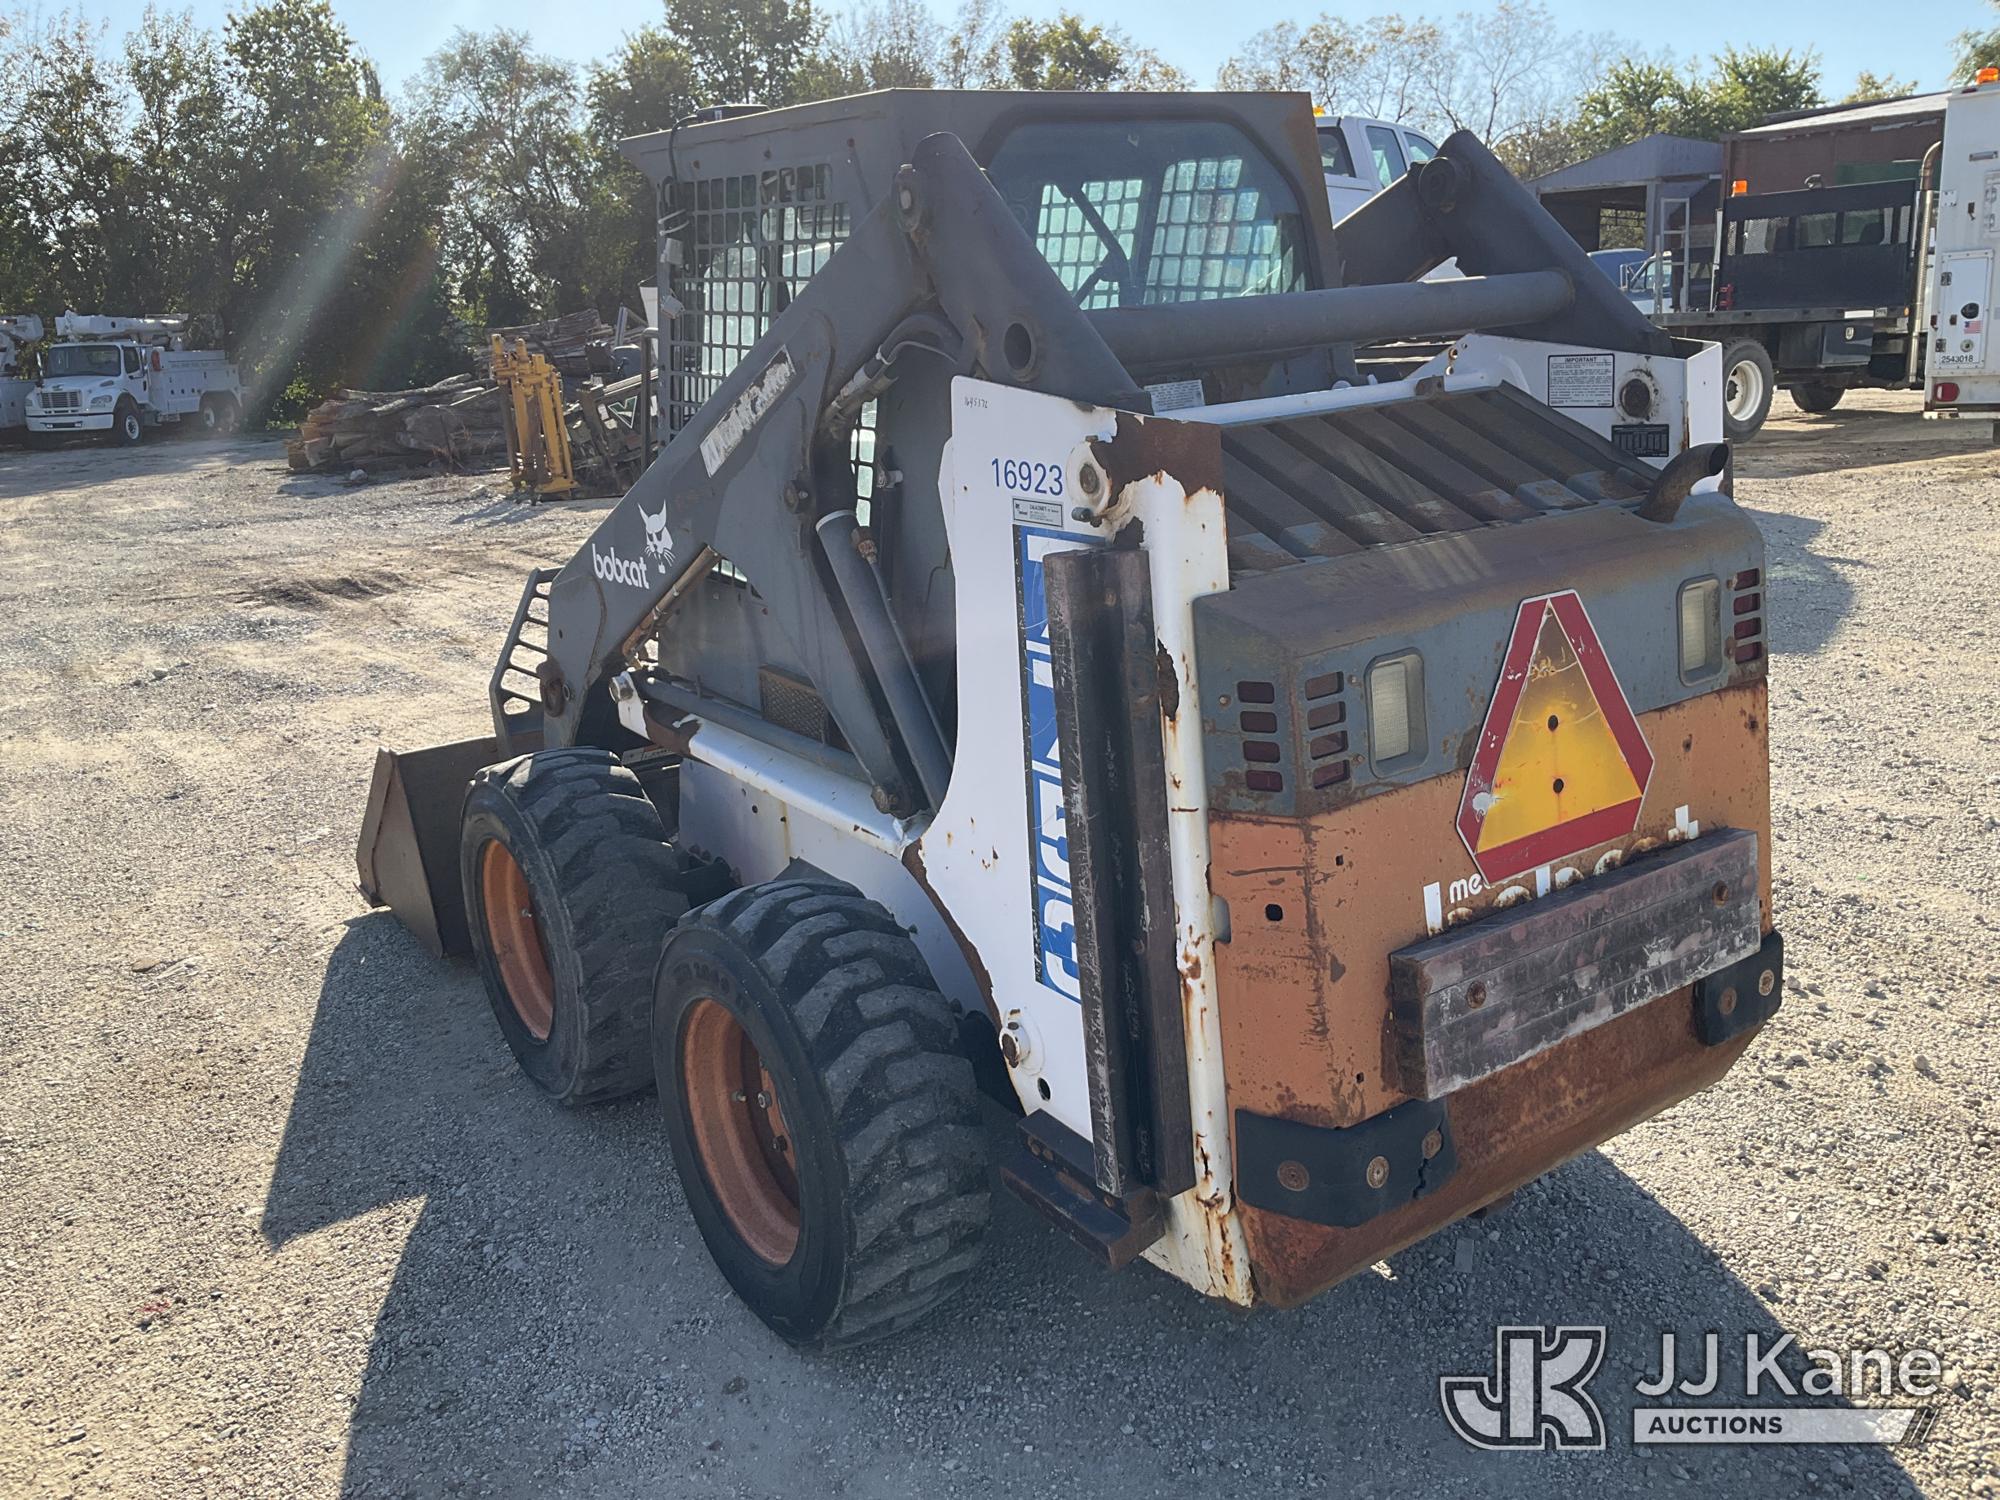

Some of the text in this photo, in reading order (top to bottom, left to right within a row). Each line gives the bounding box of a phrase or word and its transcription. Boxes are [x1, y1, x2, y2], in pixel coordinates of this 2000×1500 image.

[1941, 354, 1974, 363] 2543018
[991, 458, 1063, 496] 16923
[591, 543, 650, 589] bobcat
